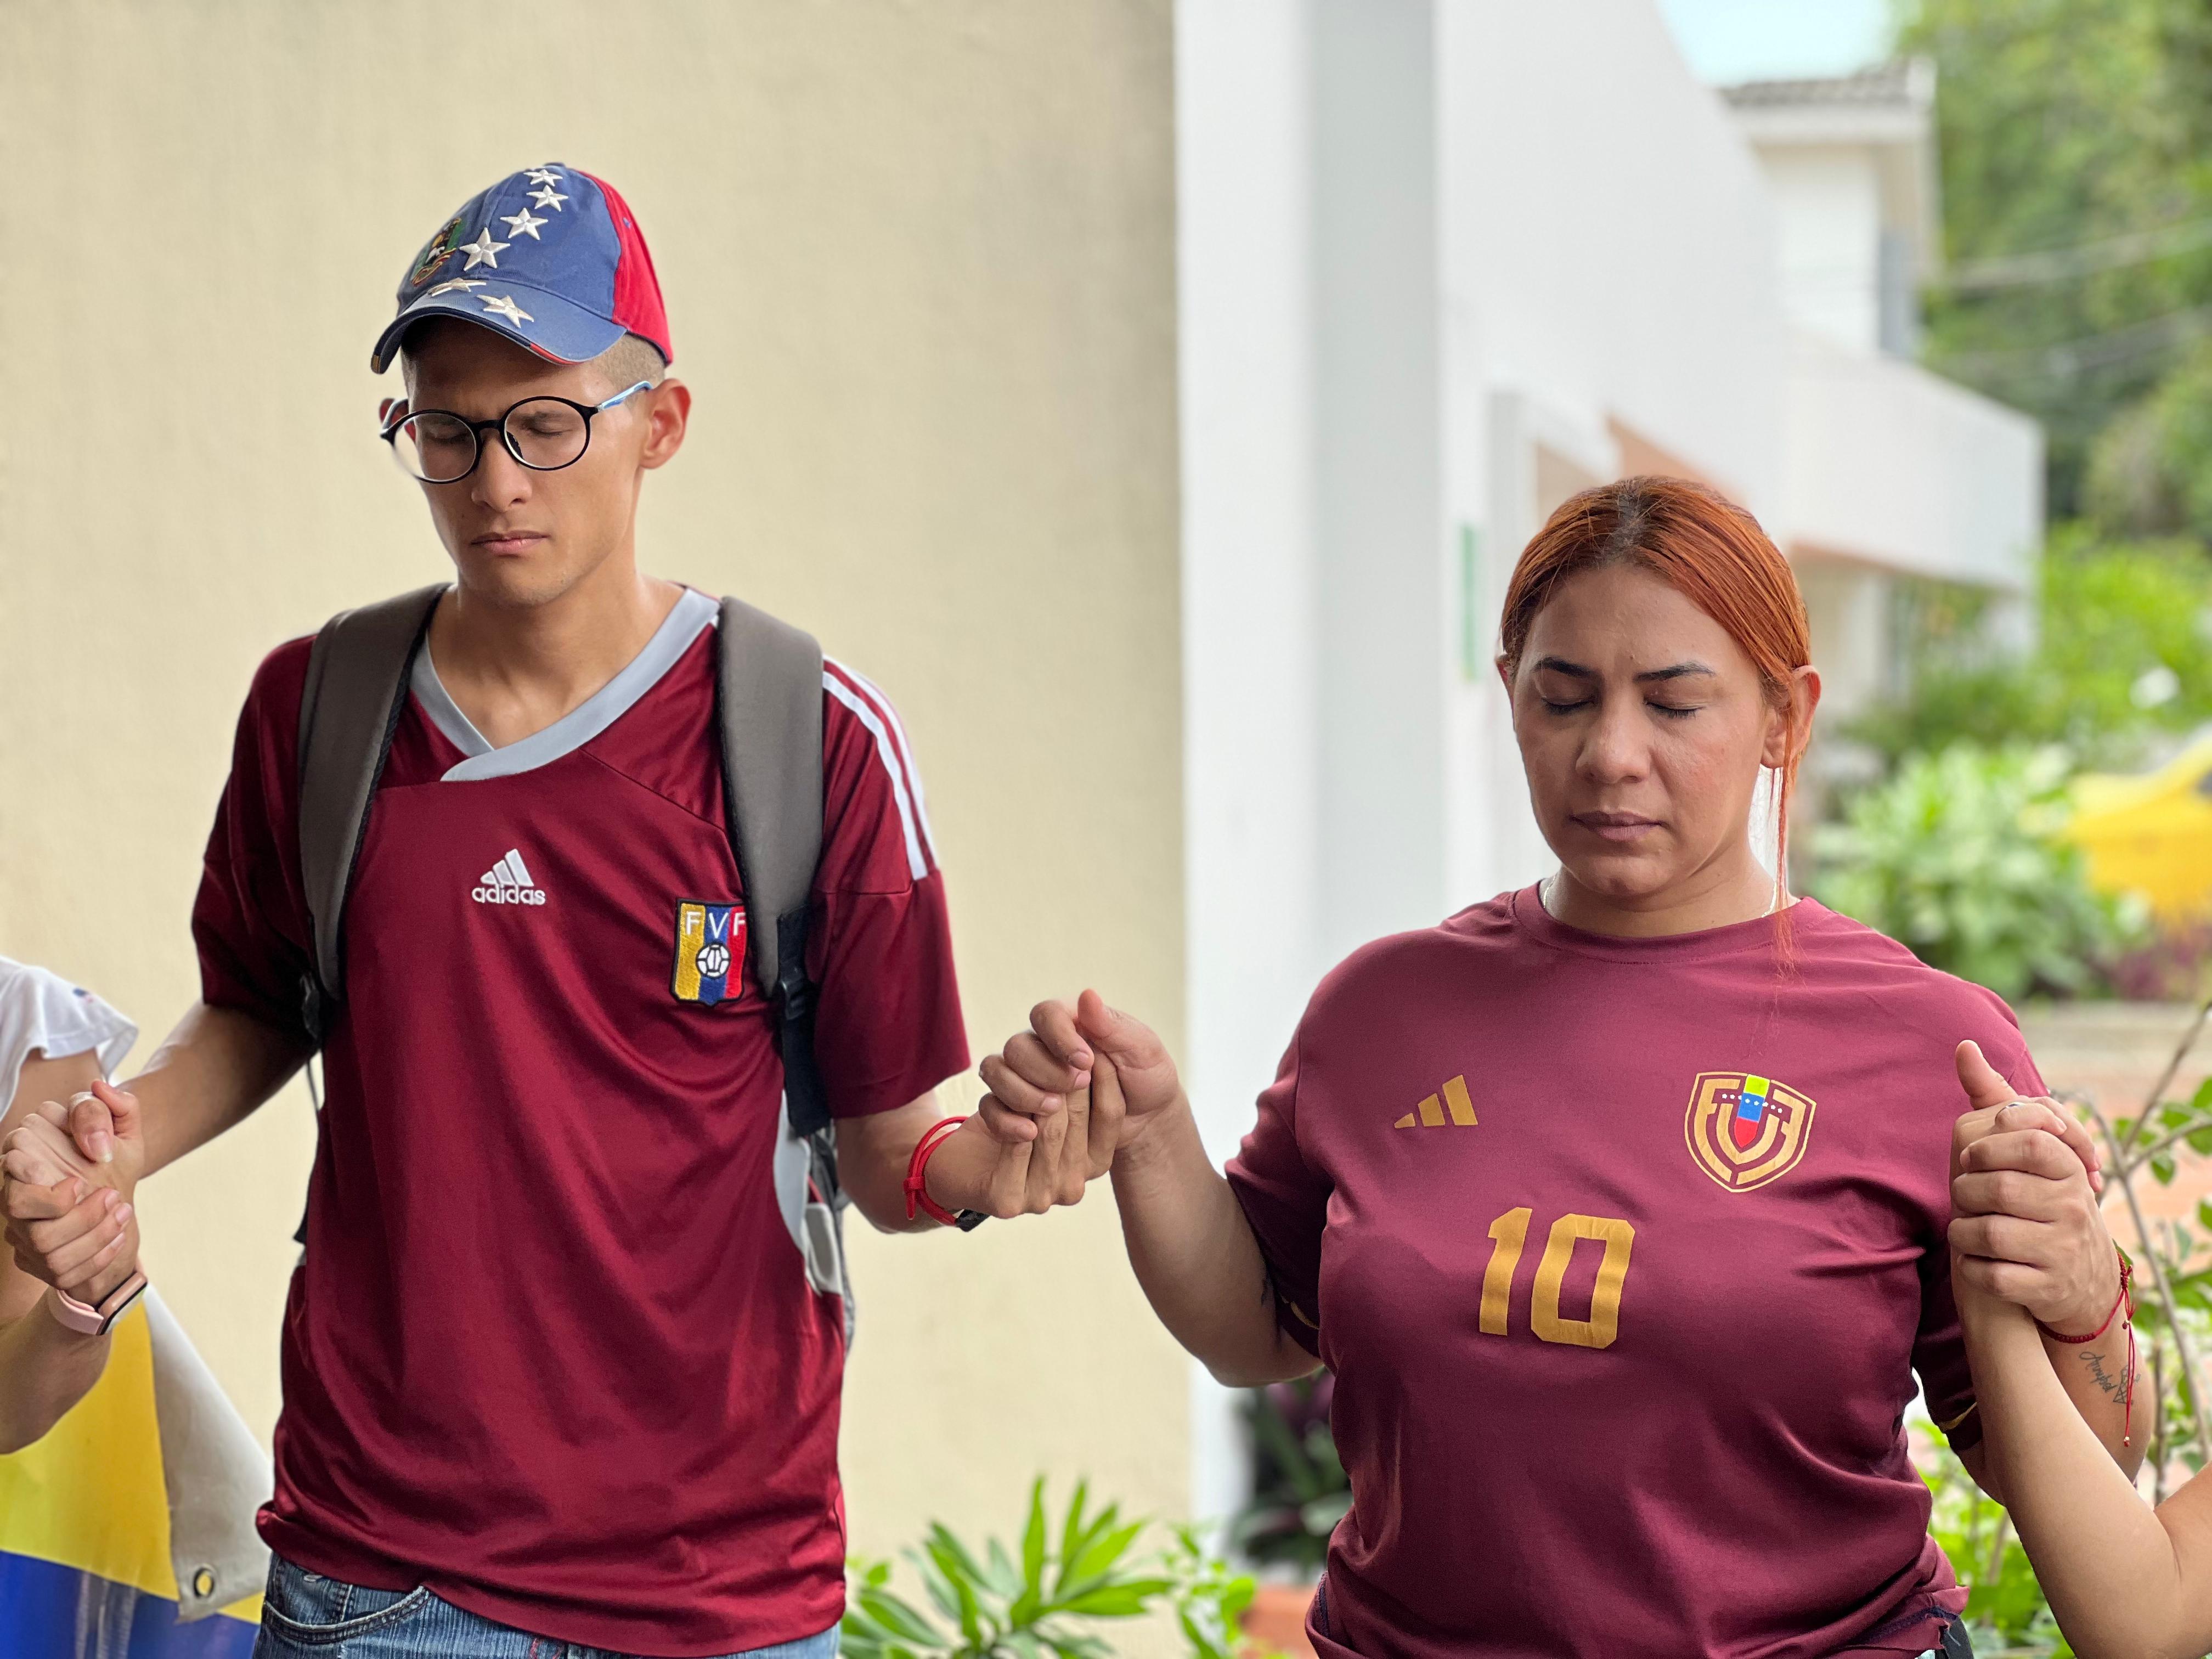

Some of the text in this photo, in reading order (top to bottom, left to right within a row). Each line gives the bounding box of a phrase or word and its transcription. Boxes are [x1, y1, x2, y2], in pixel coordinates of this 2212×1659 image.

[471, 883, 546, 905] adidas
[685, 910, 747, 939] FVF
[1479, 1206, 1636, 1350] 10
